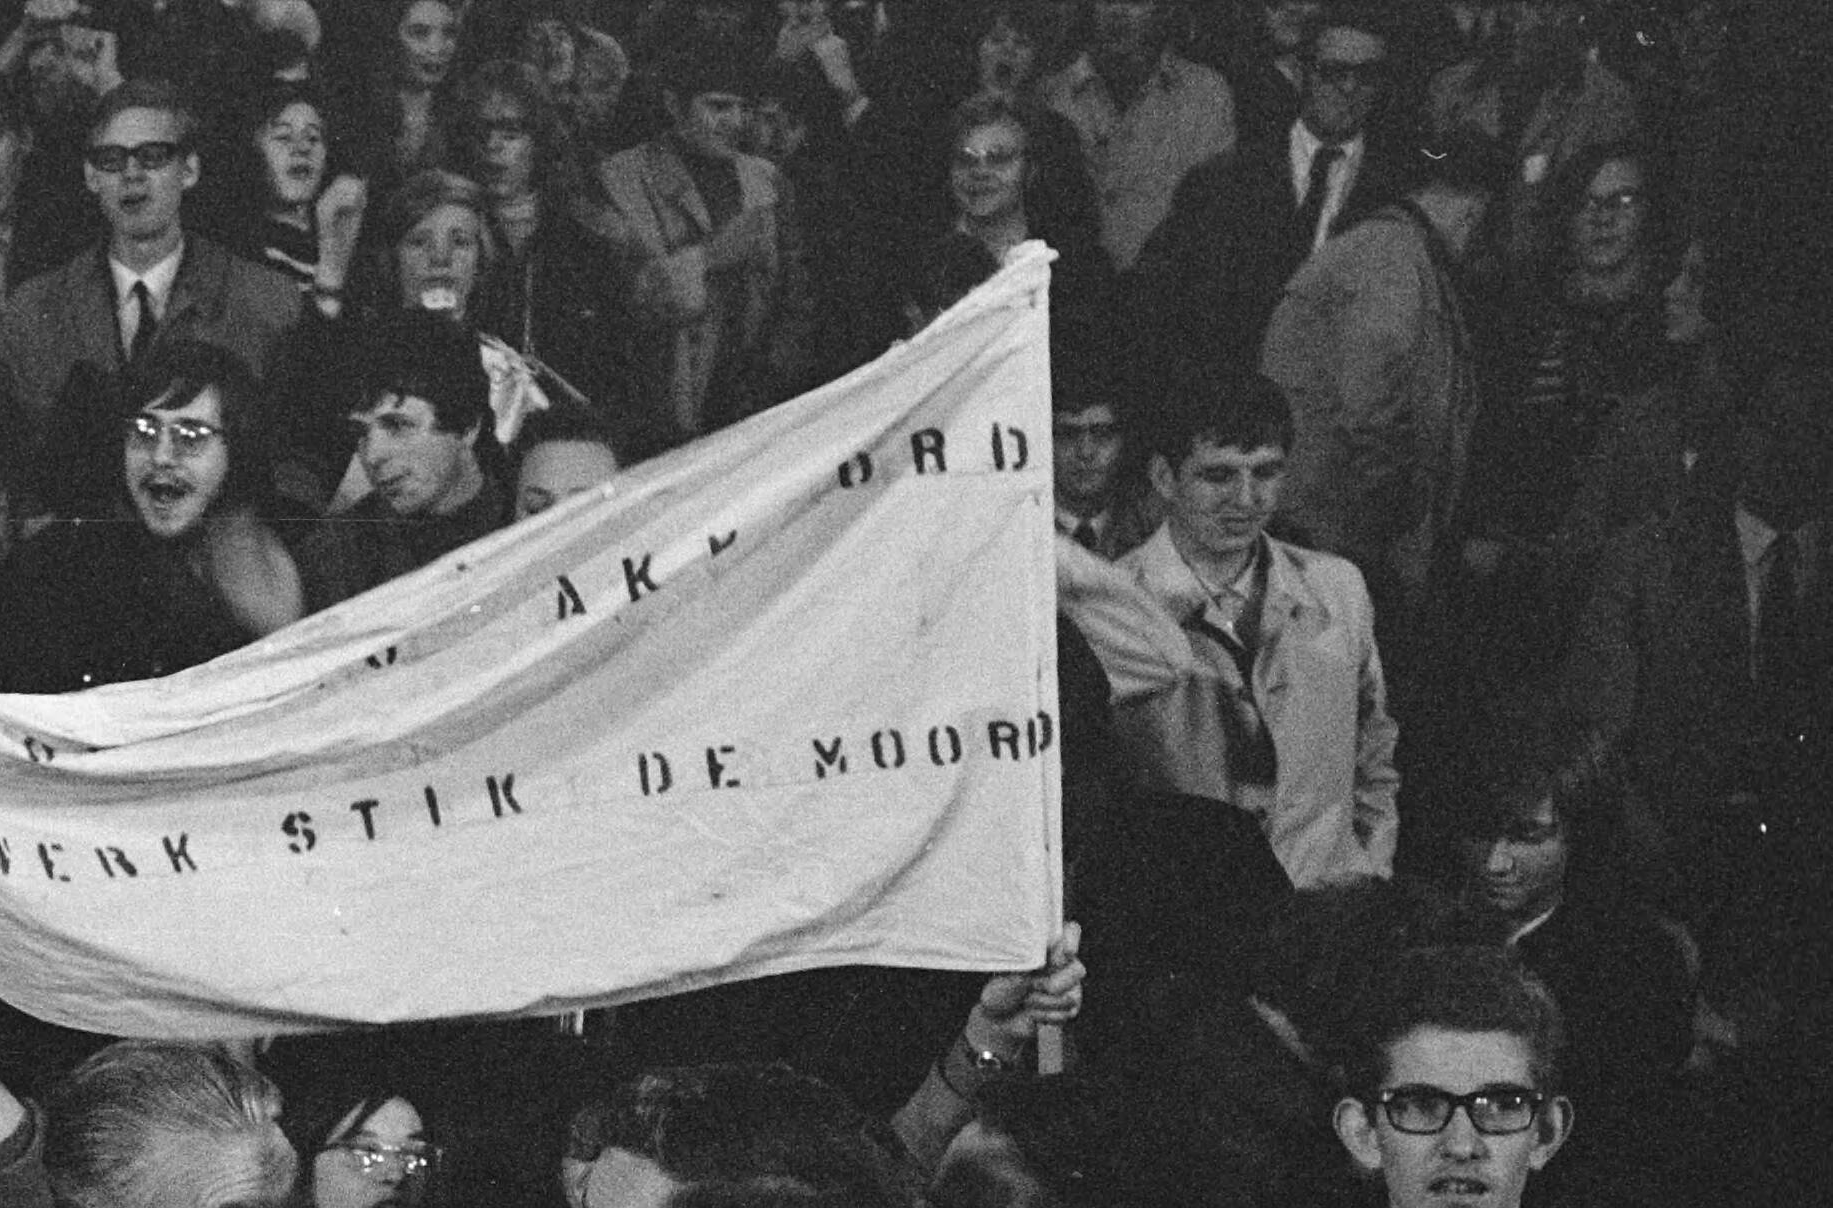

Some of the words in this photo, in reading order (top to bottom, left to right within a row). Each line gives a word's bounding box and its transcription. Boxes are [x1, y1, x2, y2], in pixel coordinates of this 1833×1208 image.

[555, 421, 1029, 622] AKORD
[280, 772, 524, 854] STIK
[637, 744, 742, 797] DE
[811, 710, 1054, 780] MOORD
